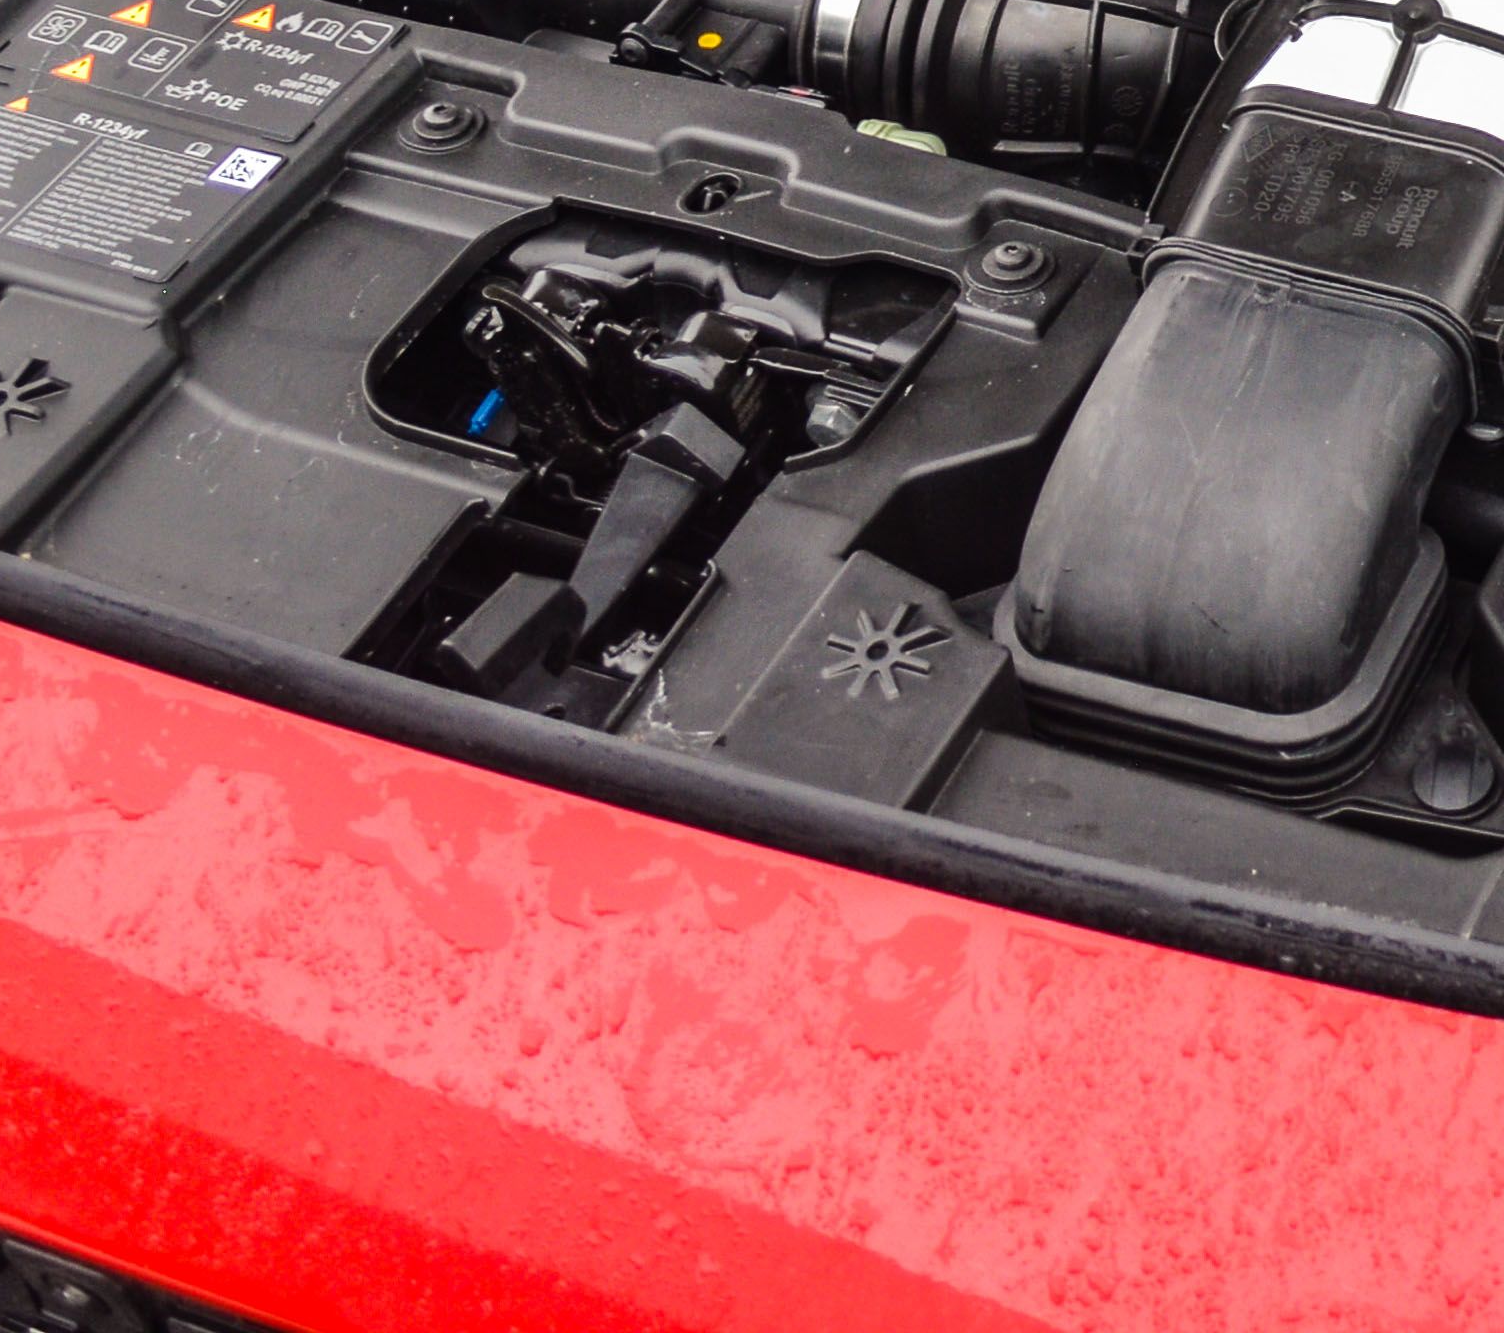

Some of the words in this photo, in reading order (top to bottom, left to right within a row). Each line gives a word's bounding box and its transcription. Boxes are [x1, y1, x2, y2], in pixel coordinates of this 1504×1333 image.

[244, 37, 315, 65] R-1234yf
[202, 91, 248, 111] POE
[72, 112, 149, 140] R-1234yf
[1385, 185, 1422, 234] Group
[1396, 187, 1440, 249] Renault
